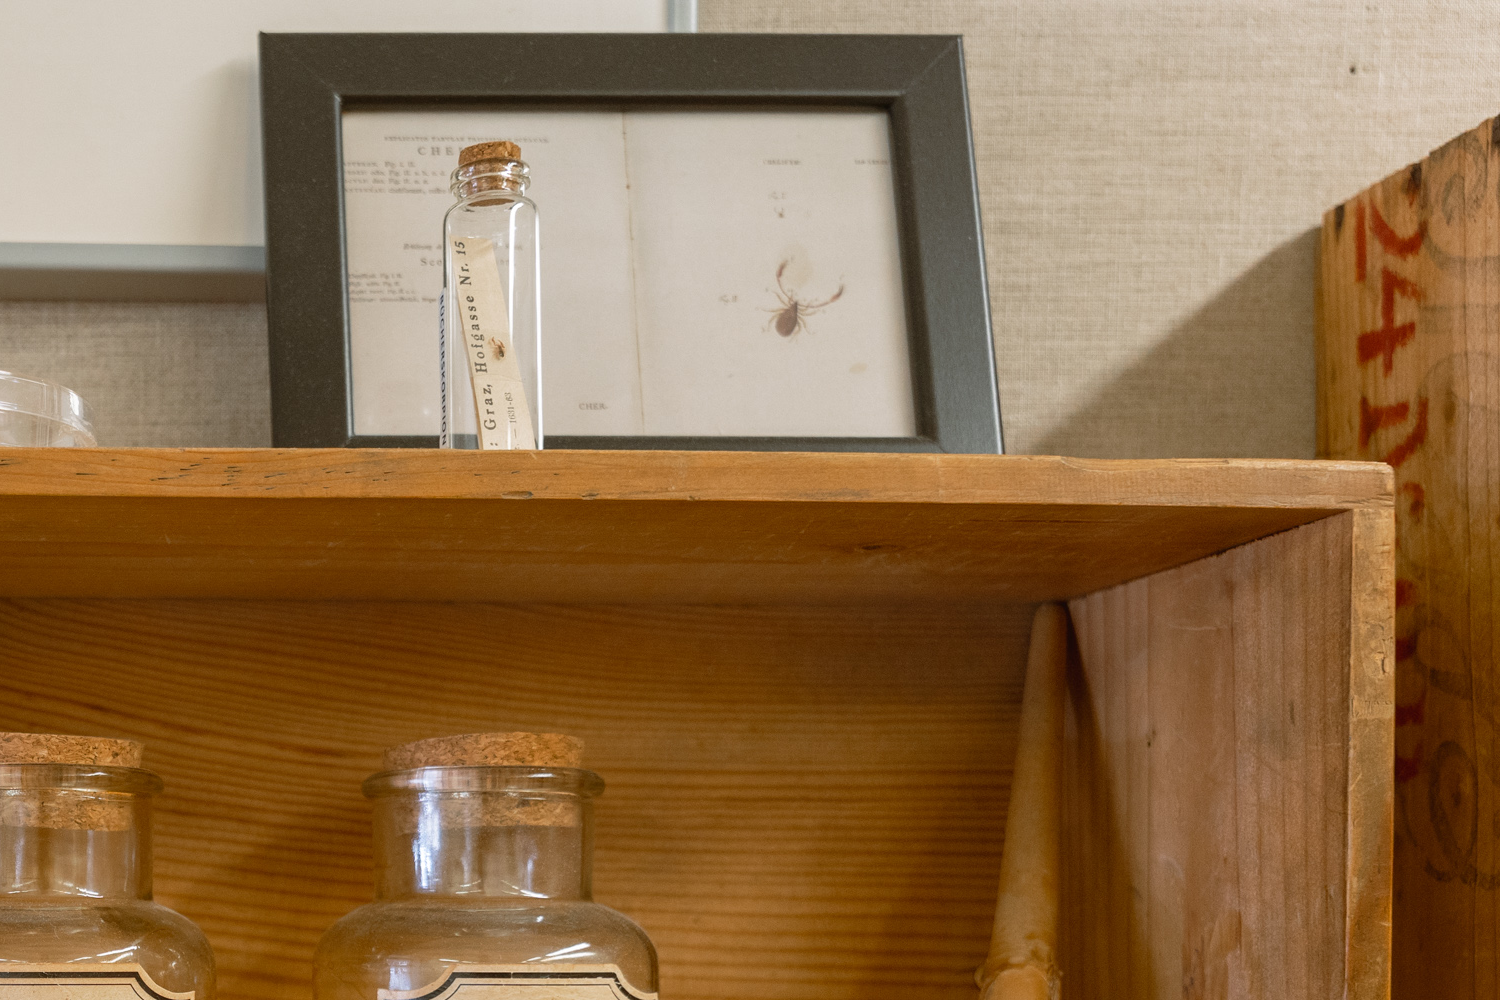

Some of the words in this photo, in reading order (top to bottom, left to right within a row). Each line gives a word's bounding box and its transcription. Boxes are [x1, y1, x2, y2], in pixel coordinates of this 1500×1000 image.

[454, 240, 467, 256] 15
[458, 263, 472, 286] Nr.
[465, 295, 488, 374] Hofgasse
[483, 383, 497, 431] Graz,
